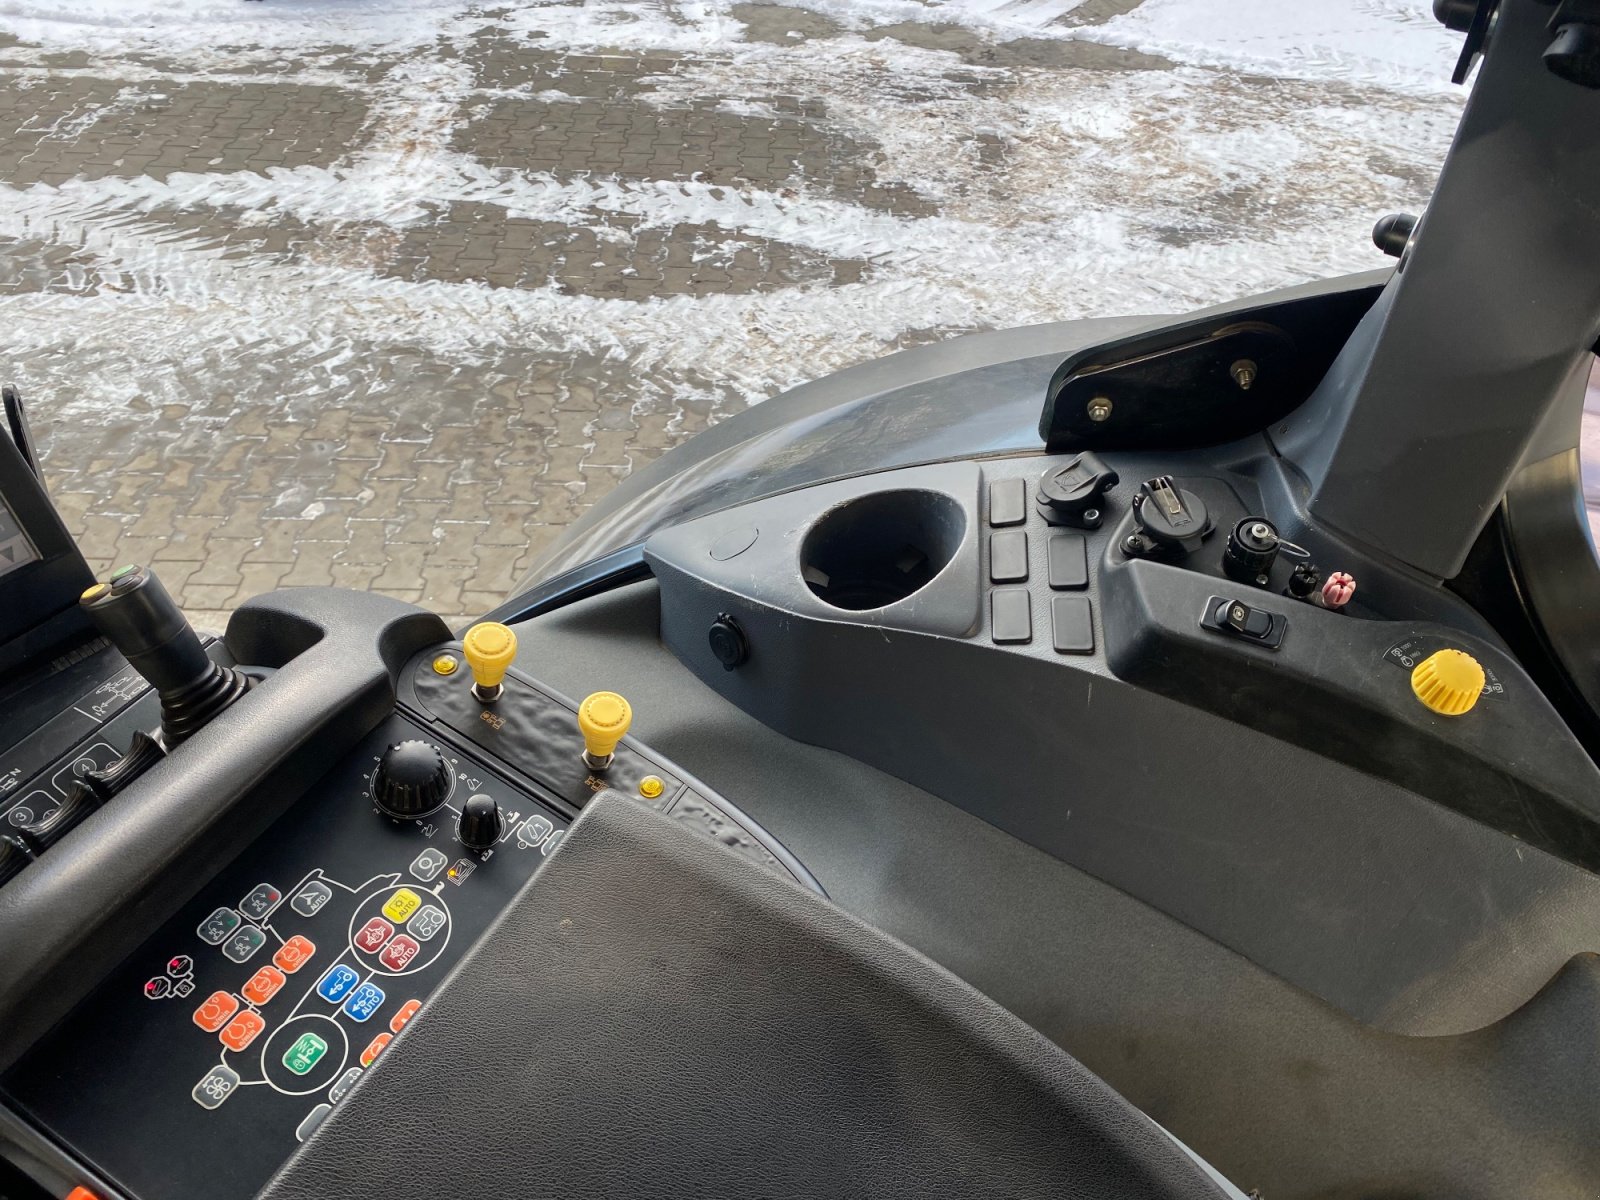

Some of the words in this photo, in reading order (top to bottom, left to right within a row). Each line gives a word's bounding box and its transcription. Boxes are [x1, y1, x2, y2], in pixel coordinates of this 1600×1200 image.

[81, 764, 90, 772] 4
[15, 812, 26, 822] 3
[310, 894, 326, 912] AUTO
[398, 900, 416, 918] AUTO
[397, 947, 415, 966] AUTO
[362, 996, 380, 1016] AUTO
[212, 1010, 230, 1026] n/min
